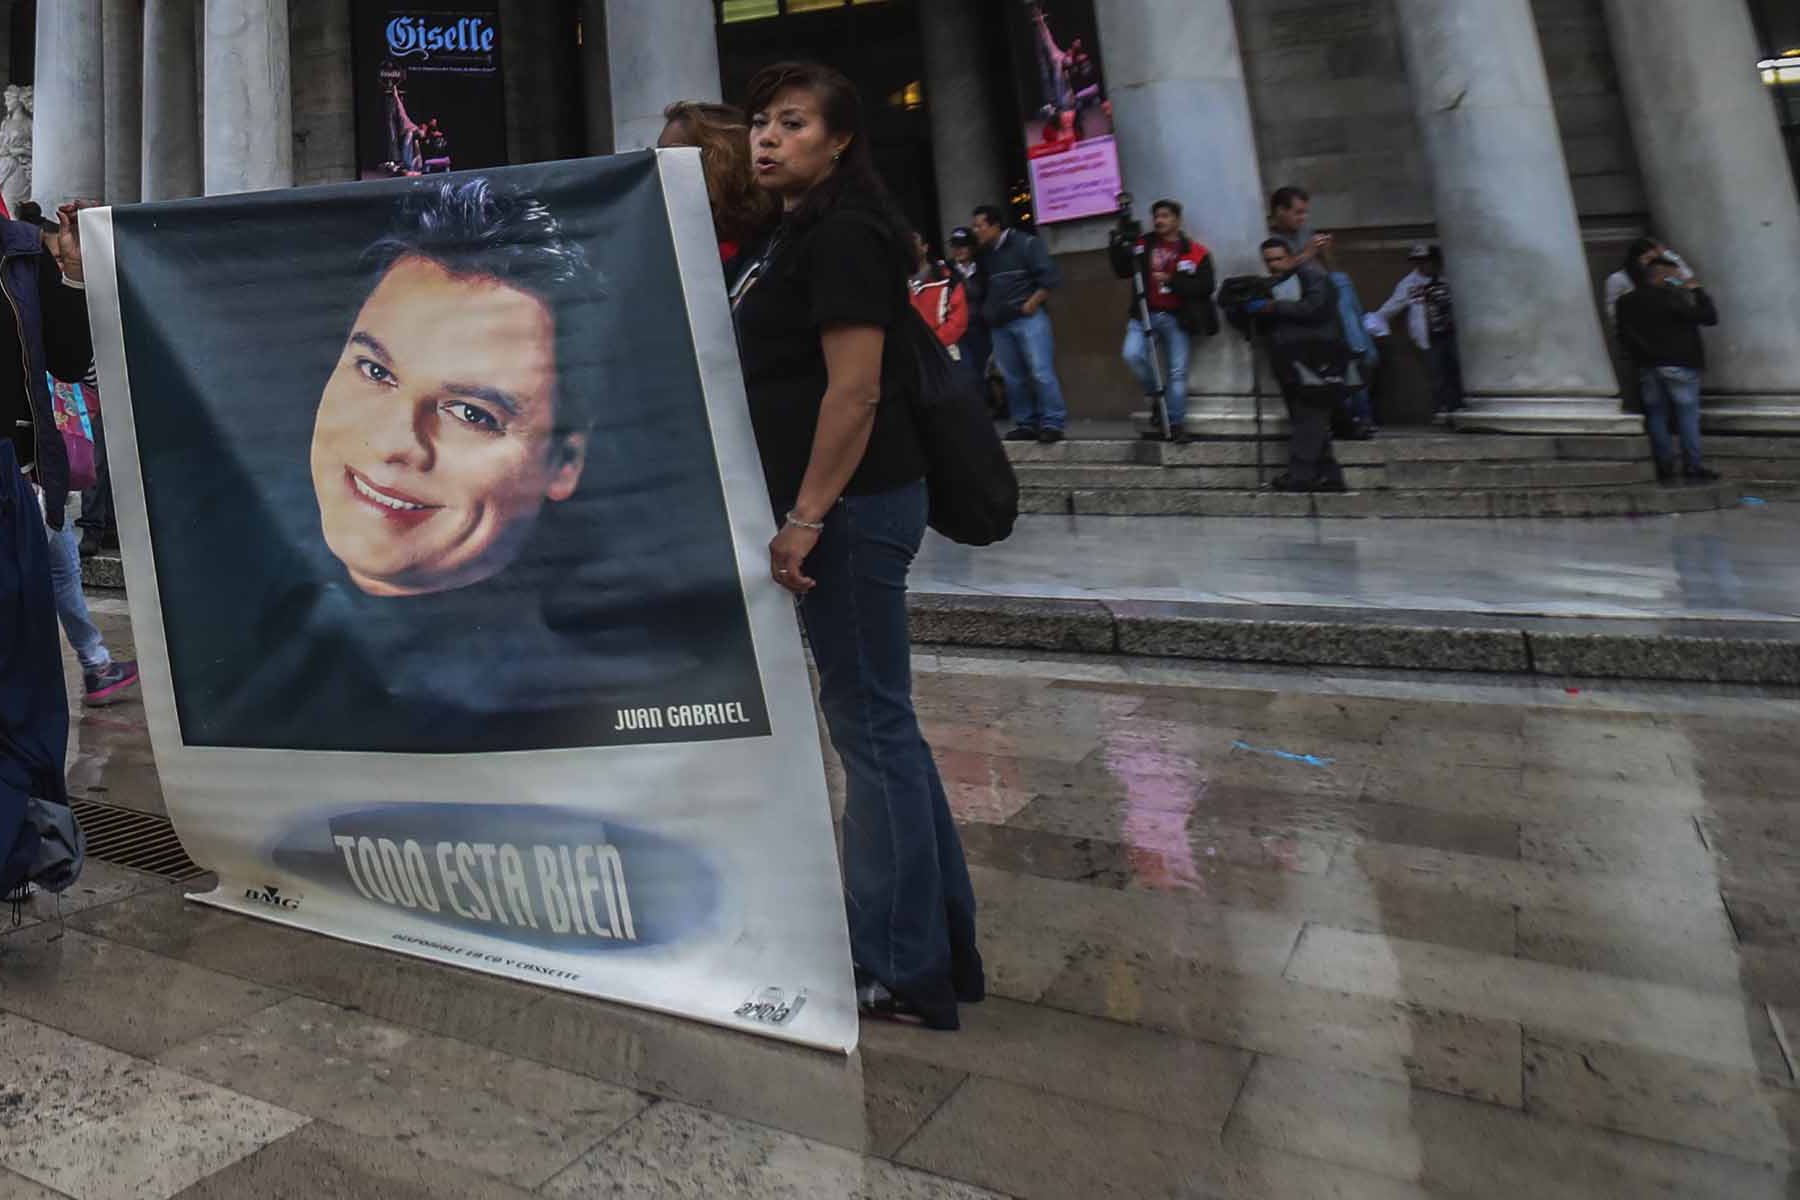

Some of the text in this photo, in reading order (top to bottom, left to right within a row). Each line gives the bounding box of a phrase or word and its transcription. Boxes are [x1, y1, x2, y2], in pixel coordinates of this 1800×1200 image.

[385, 15, 495, 60] Giselle
[614, 701, 751, 730] JUAN GABRIEL
[245, 887, 301, 911] BMG
[334, 835, 637, 941] TODO ESTA BIEN
